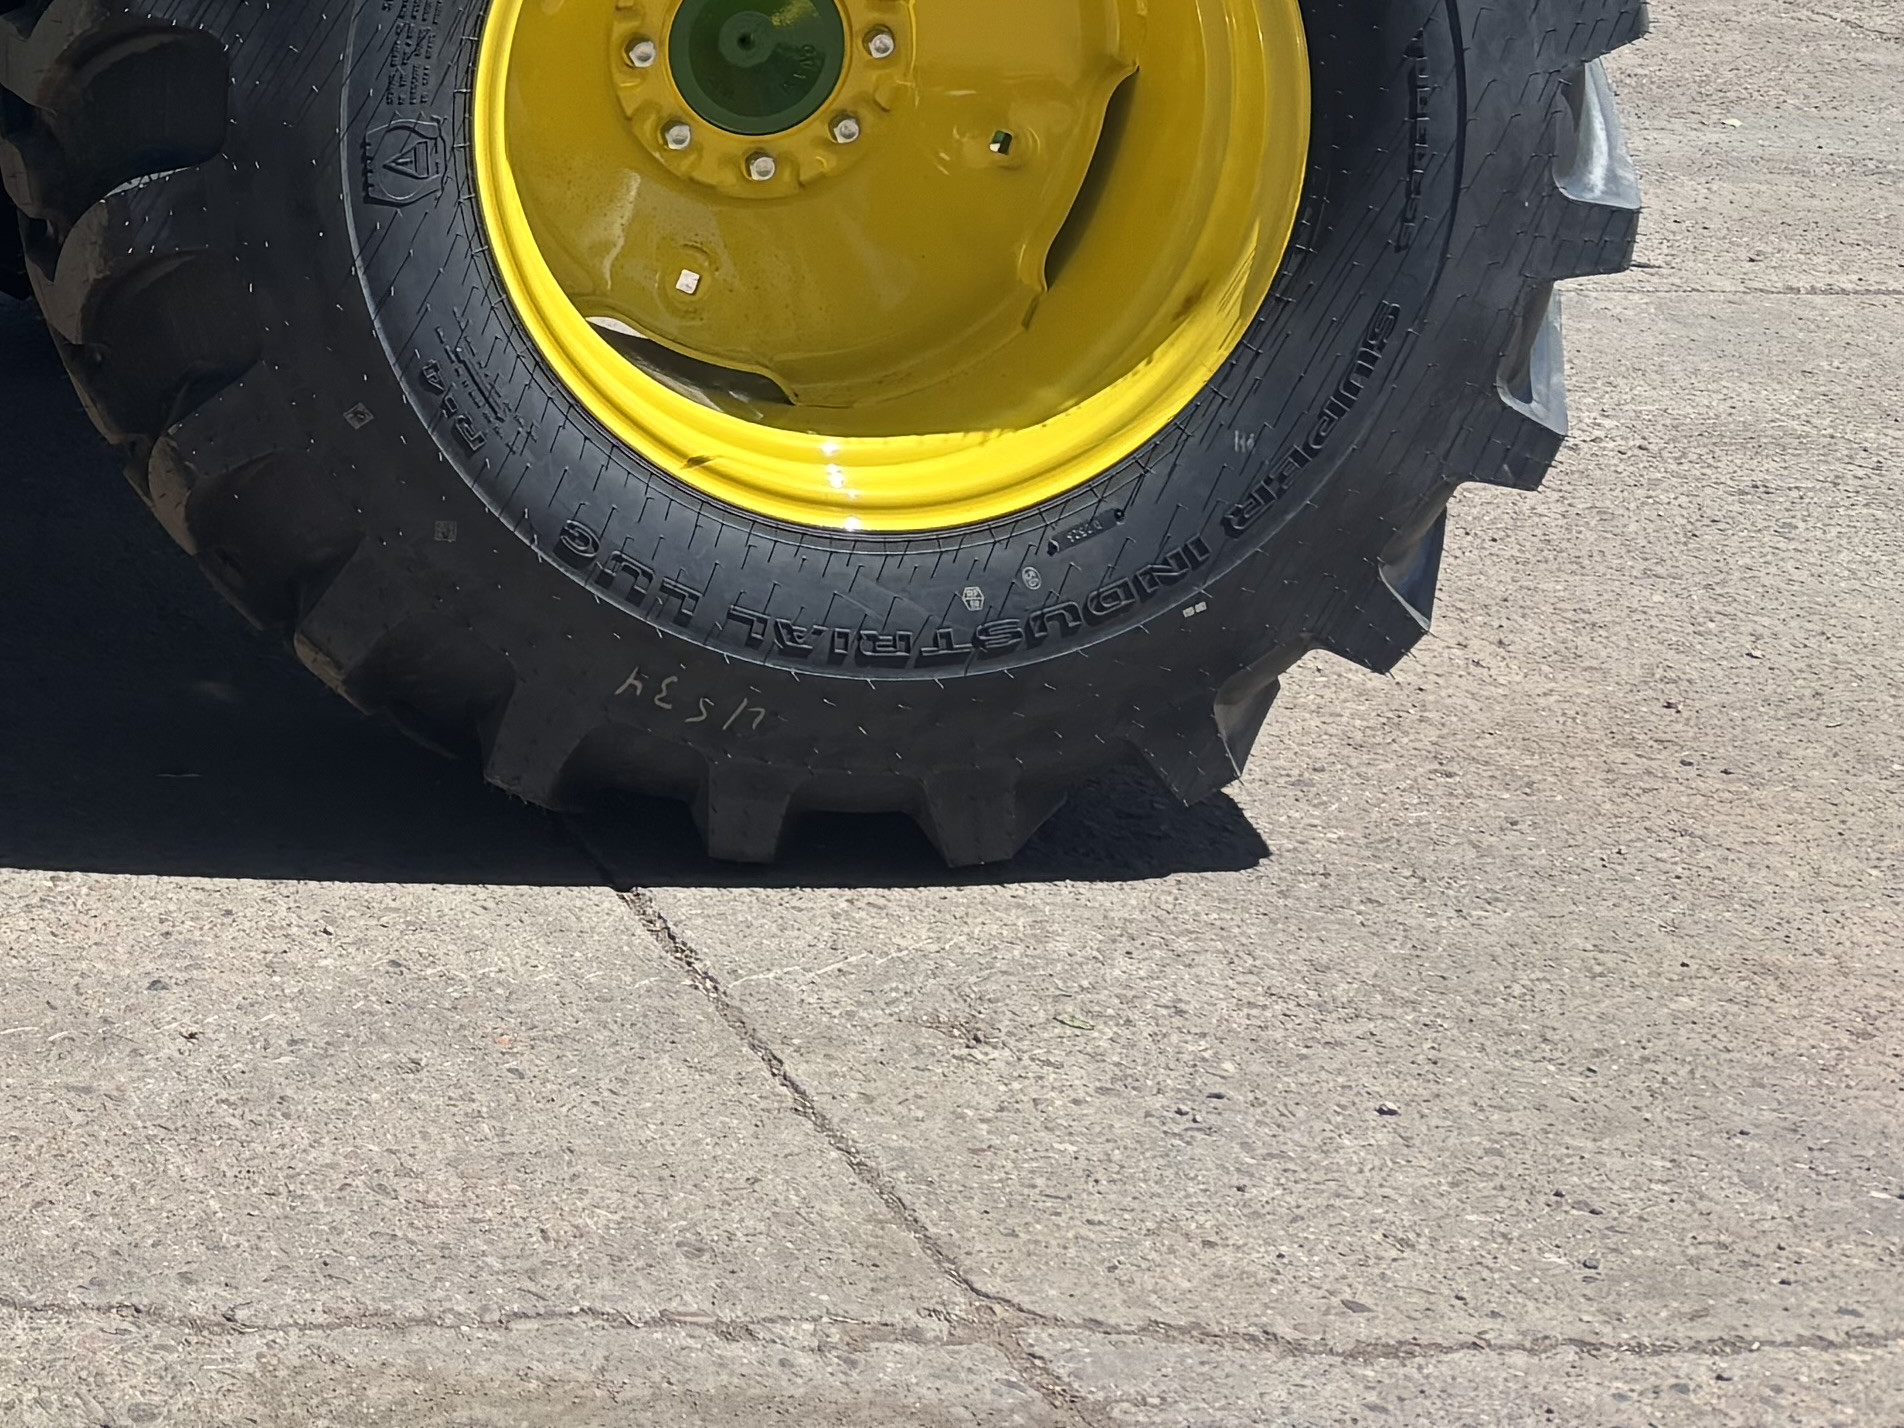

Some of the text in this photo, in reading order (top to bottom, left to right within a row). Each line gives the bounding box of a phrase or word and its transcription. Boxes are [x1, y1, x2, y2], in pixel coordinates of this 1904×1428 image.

[553, 300, 1401, 668] SUPER INDUSTRIAL LUG
